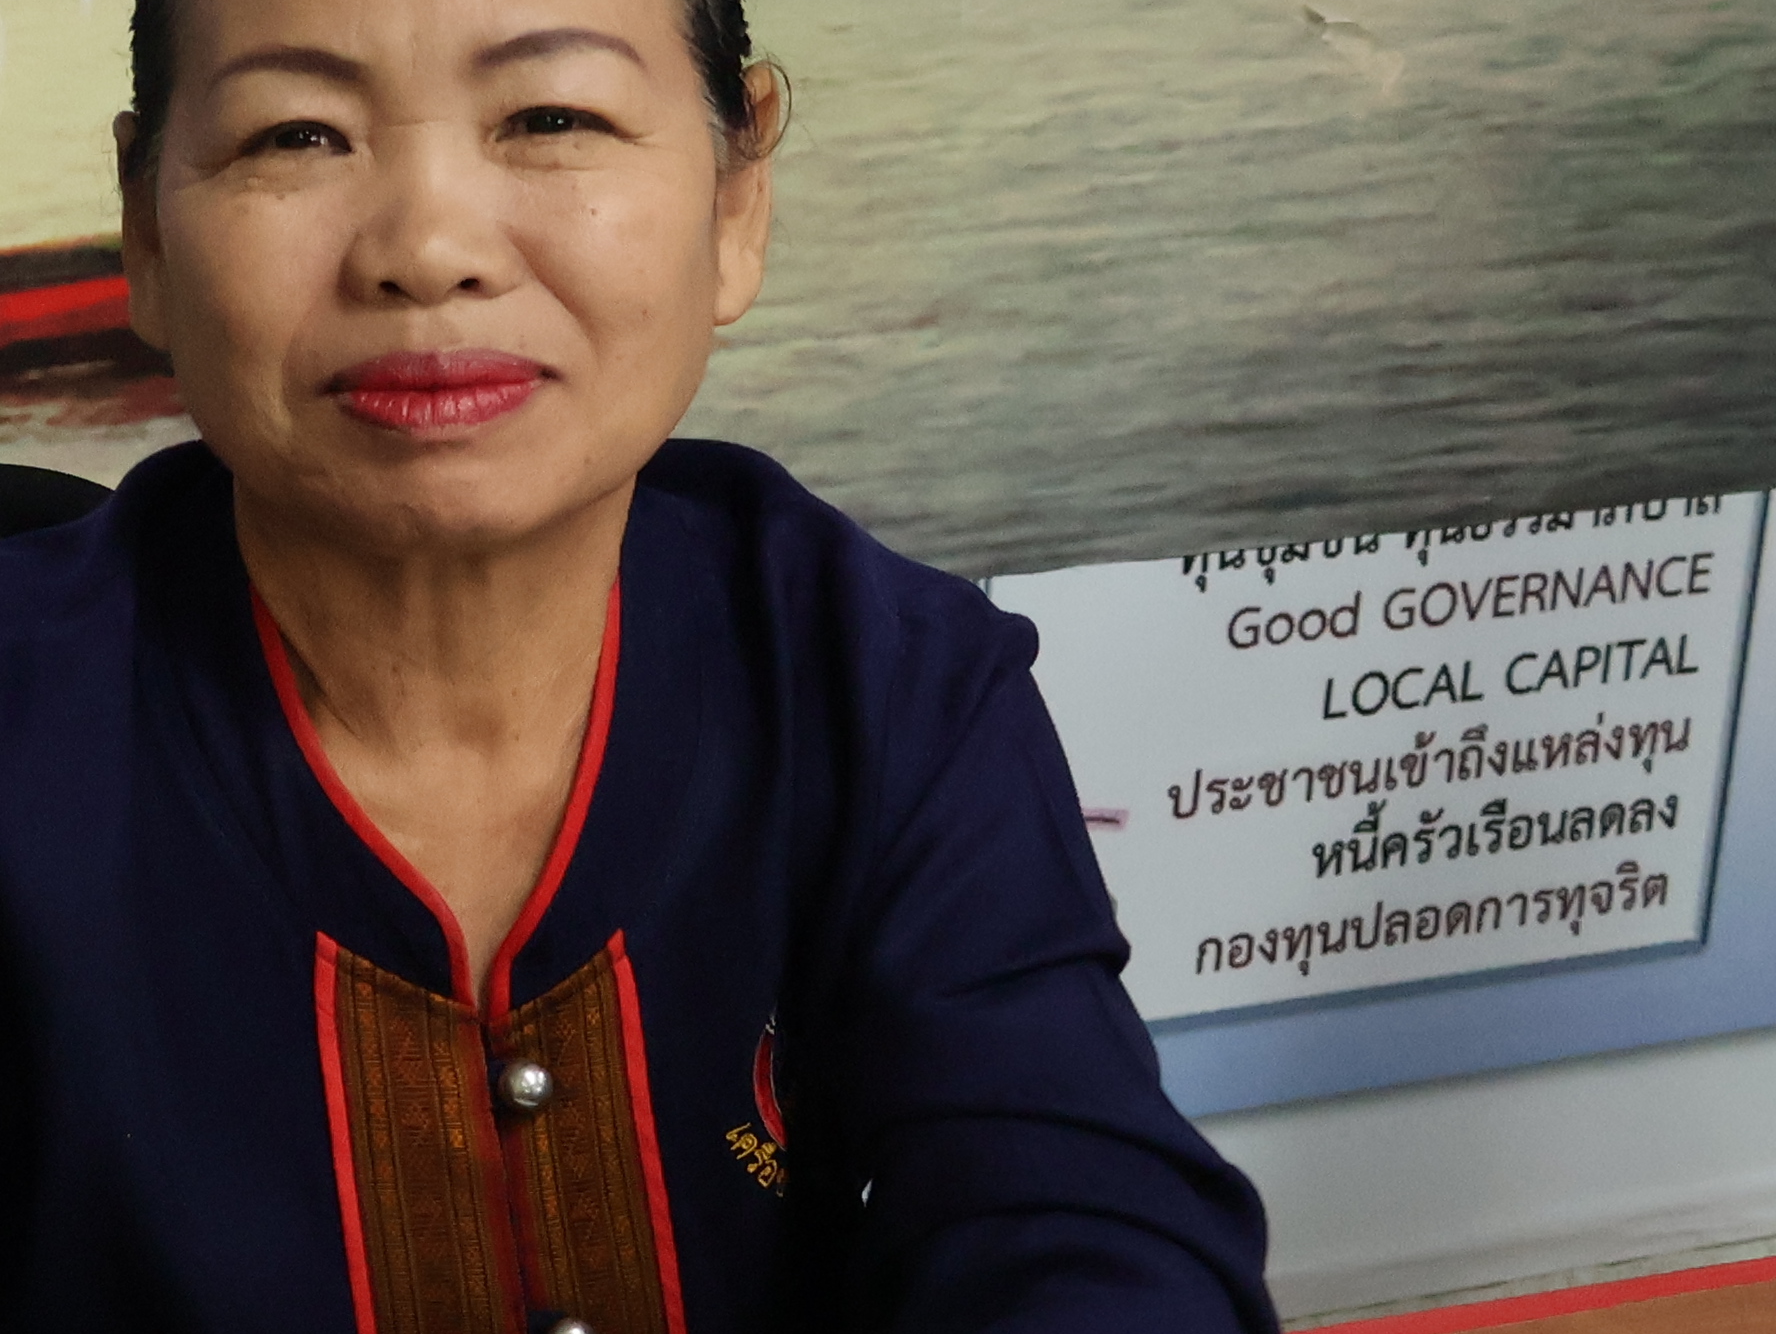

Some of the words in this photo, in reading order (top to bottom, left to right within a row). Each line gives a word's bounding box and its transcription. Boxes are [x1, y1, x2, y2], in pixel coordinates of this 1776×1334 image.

[1228, 591, 1362, 649] Good
[1383, 552, 1714, 631] GOVERNANCE
[1323, 661, 1484, 720] LOCAL
[1505, 634, 1698, 695] CAPITAL
[1167, 712, 1691, 820] ประชาชนเข้าถึงแหล่งทุน
[1312, 795, 1678, 878] หนี้ครัวเรือนลดลง
[1195, 861, 1669, 976] กองทุนปลอดการทุจริต
